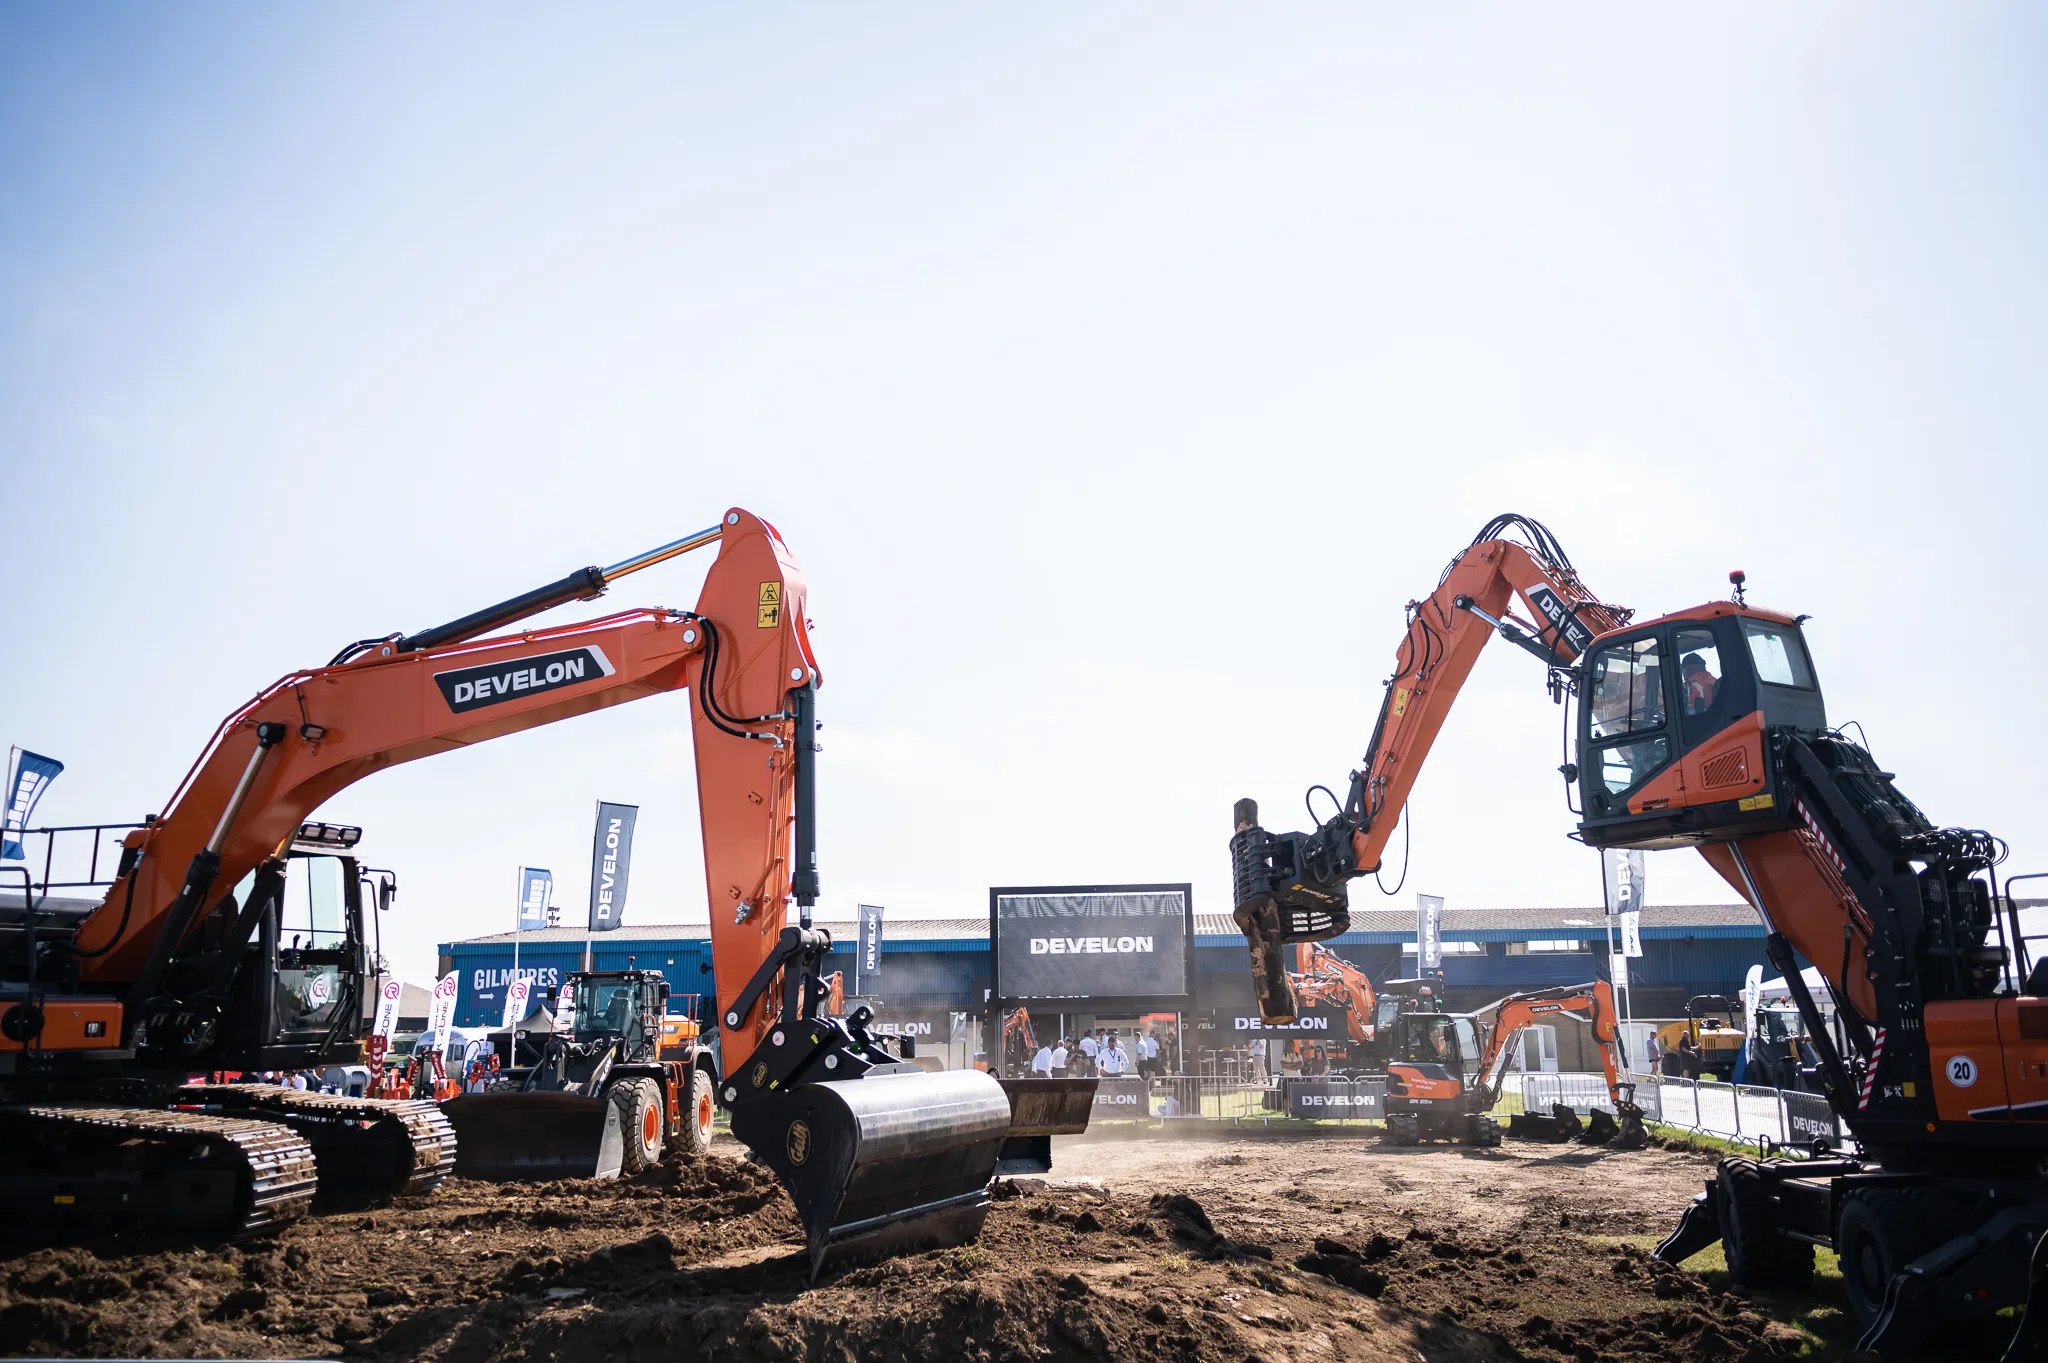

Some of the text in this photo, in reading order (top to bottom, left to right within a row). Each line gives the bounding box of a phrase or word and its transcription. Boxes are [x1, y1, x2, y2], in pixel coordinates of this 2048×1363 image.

[454, 657, 585, 703] DEVELON
[597, 818, 623, 920] DEVELON
[866, 913, 878, 970] DEVELON
[1425, 903, 1436, 962] DEVELON
[1030, 936, 1154, 955] DEVELON
[1531, 1005, 1560, 1014] DEVELON
[867, 1022, 931, 1035] VELON
[1953, 1062, 1971, 1081] 20
[1301, 1095, 1375, 1106] DEVELON
[1793, 1115, 1834, 1138] DEVELON
